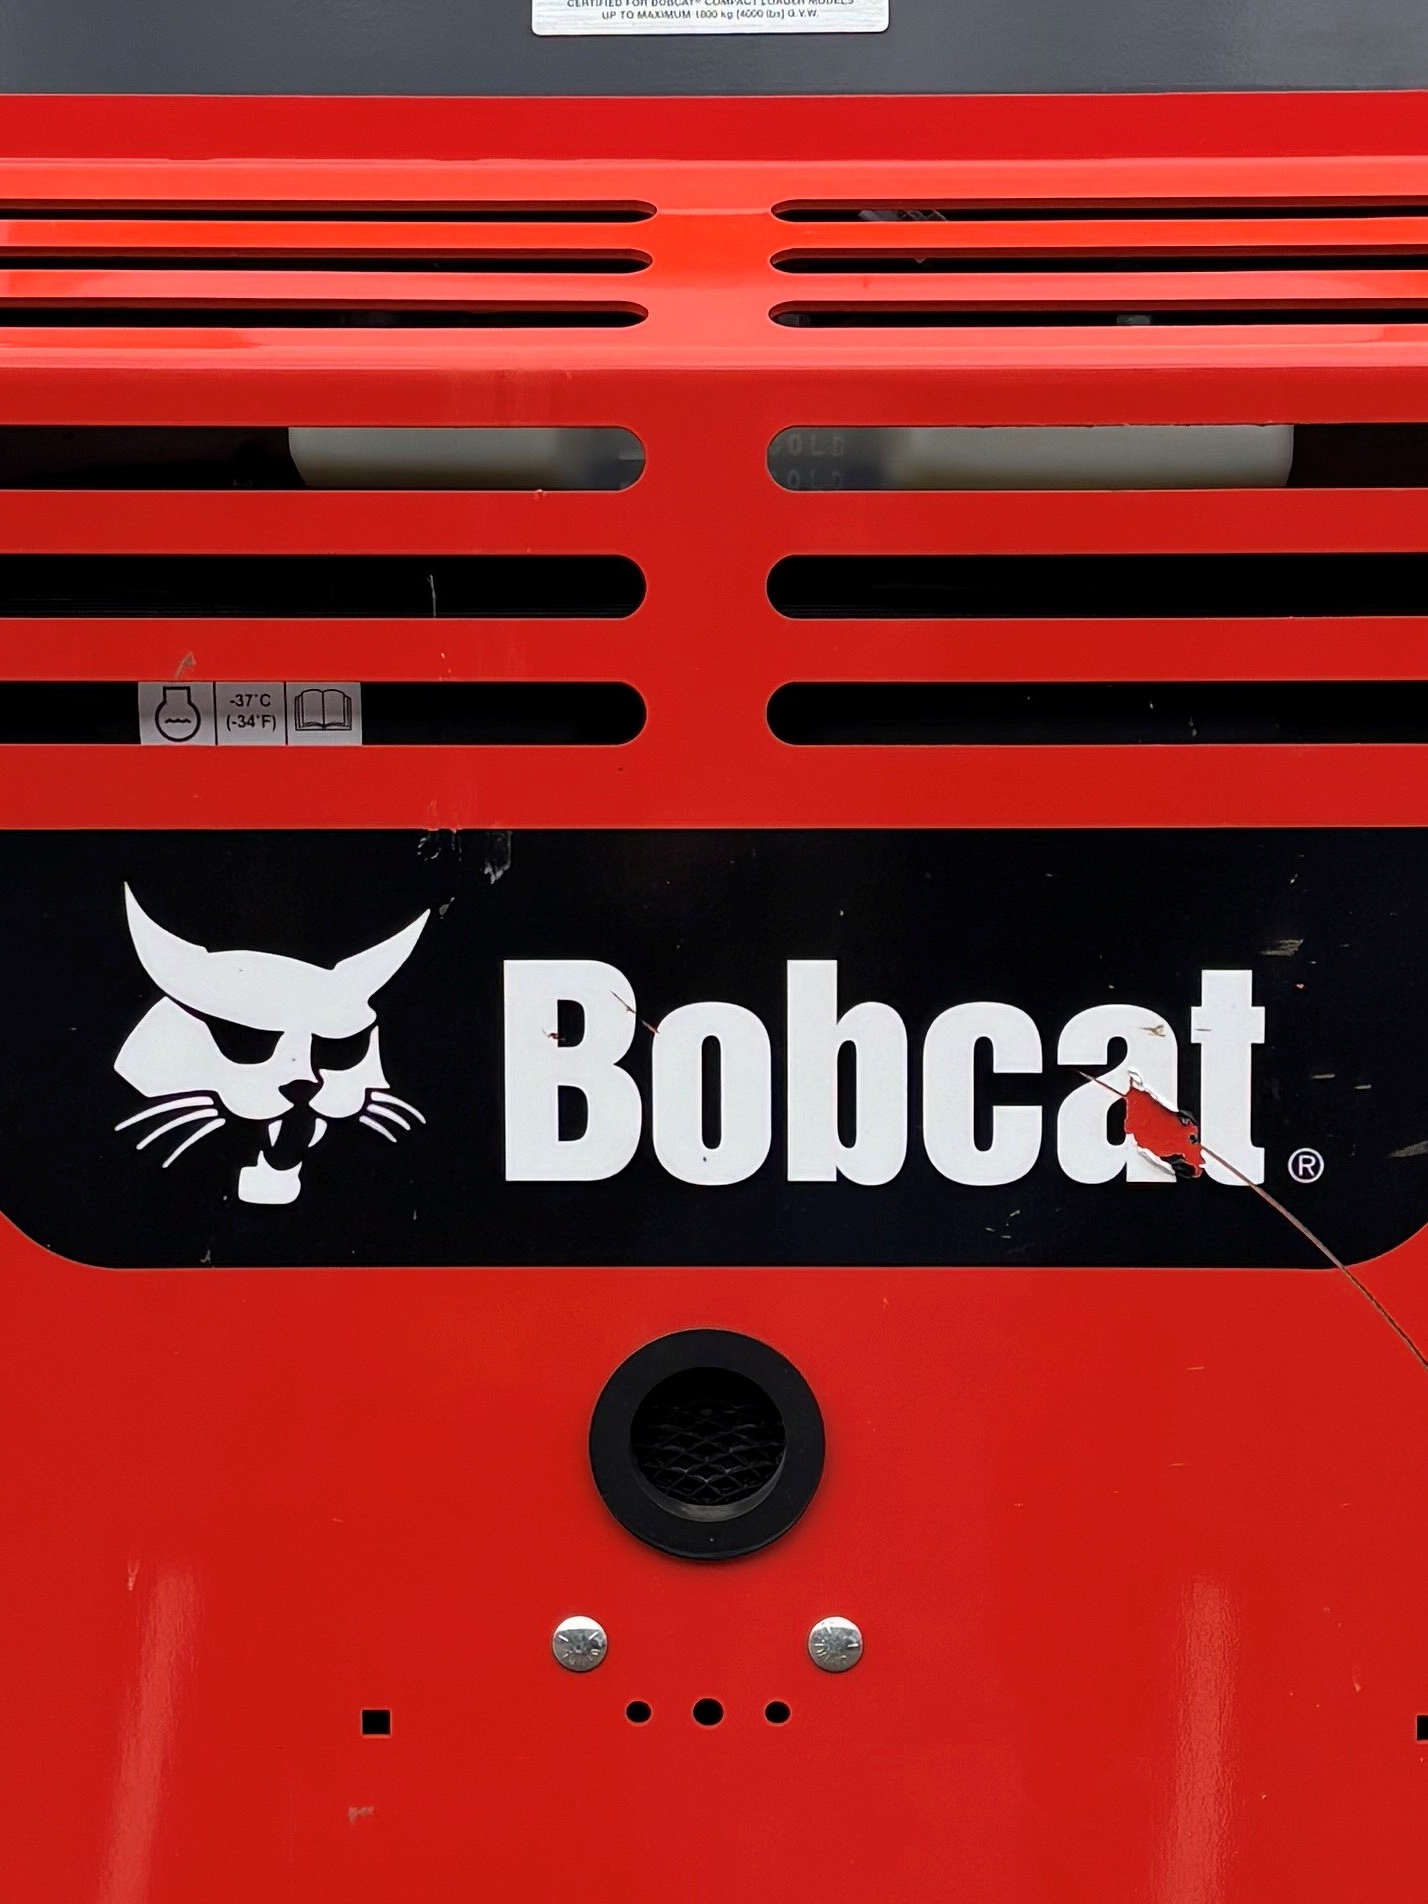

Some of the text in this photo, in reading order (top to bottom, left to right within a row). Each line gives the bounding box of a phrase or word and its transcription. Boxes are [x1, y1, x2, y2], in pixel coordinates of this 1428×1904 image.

[601, 11, 617, 20] UP
[620, 10, 634, 19] TO
[637, 10, 691, 19] MAXIMUM
[504, 959, 1265, 1185] Bobcat
